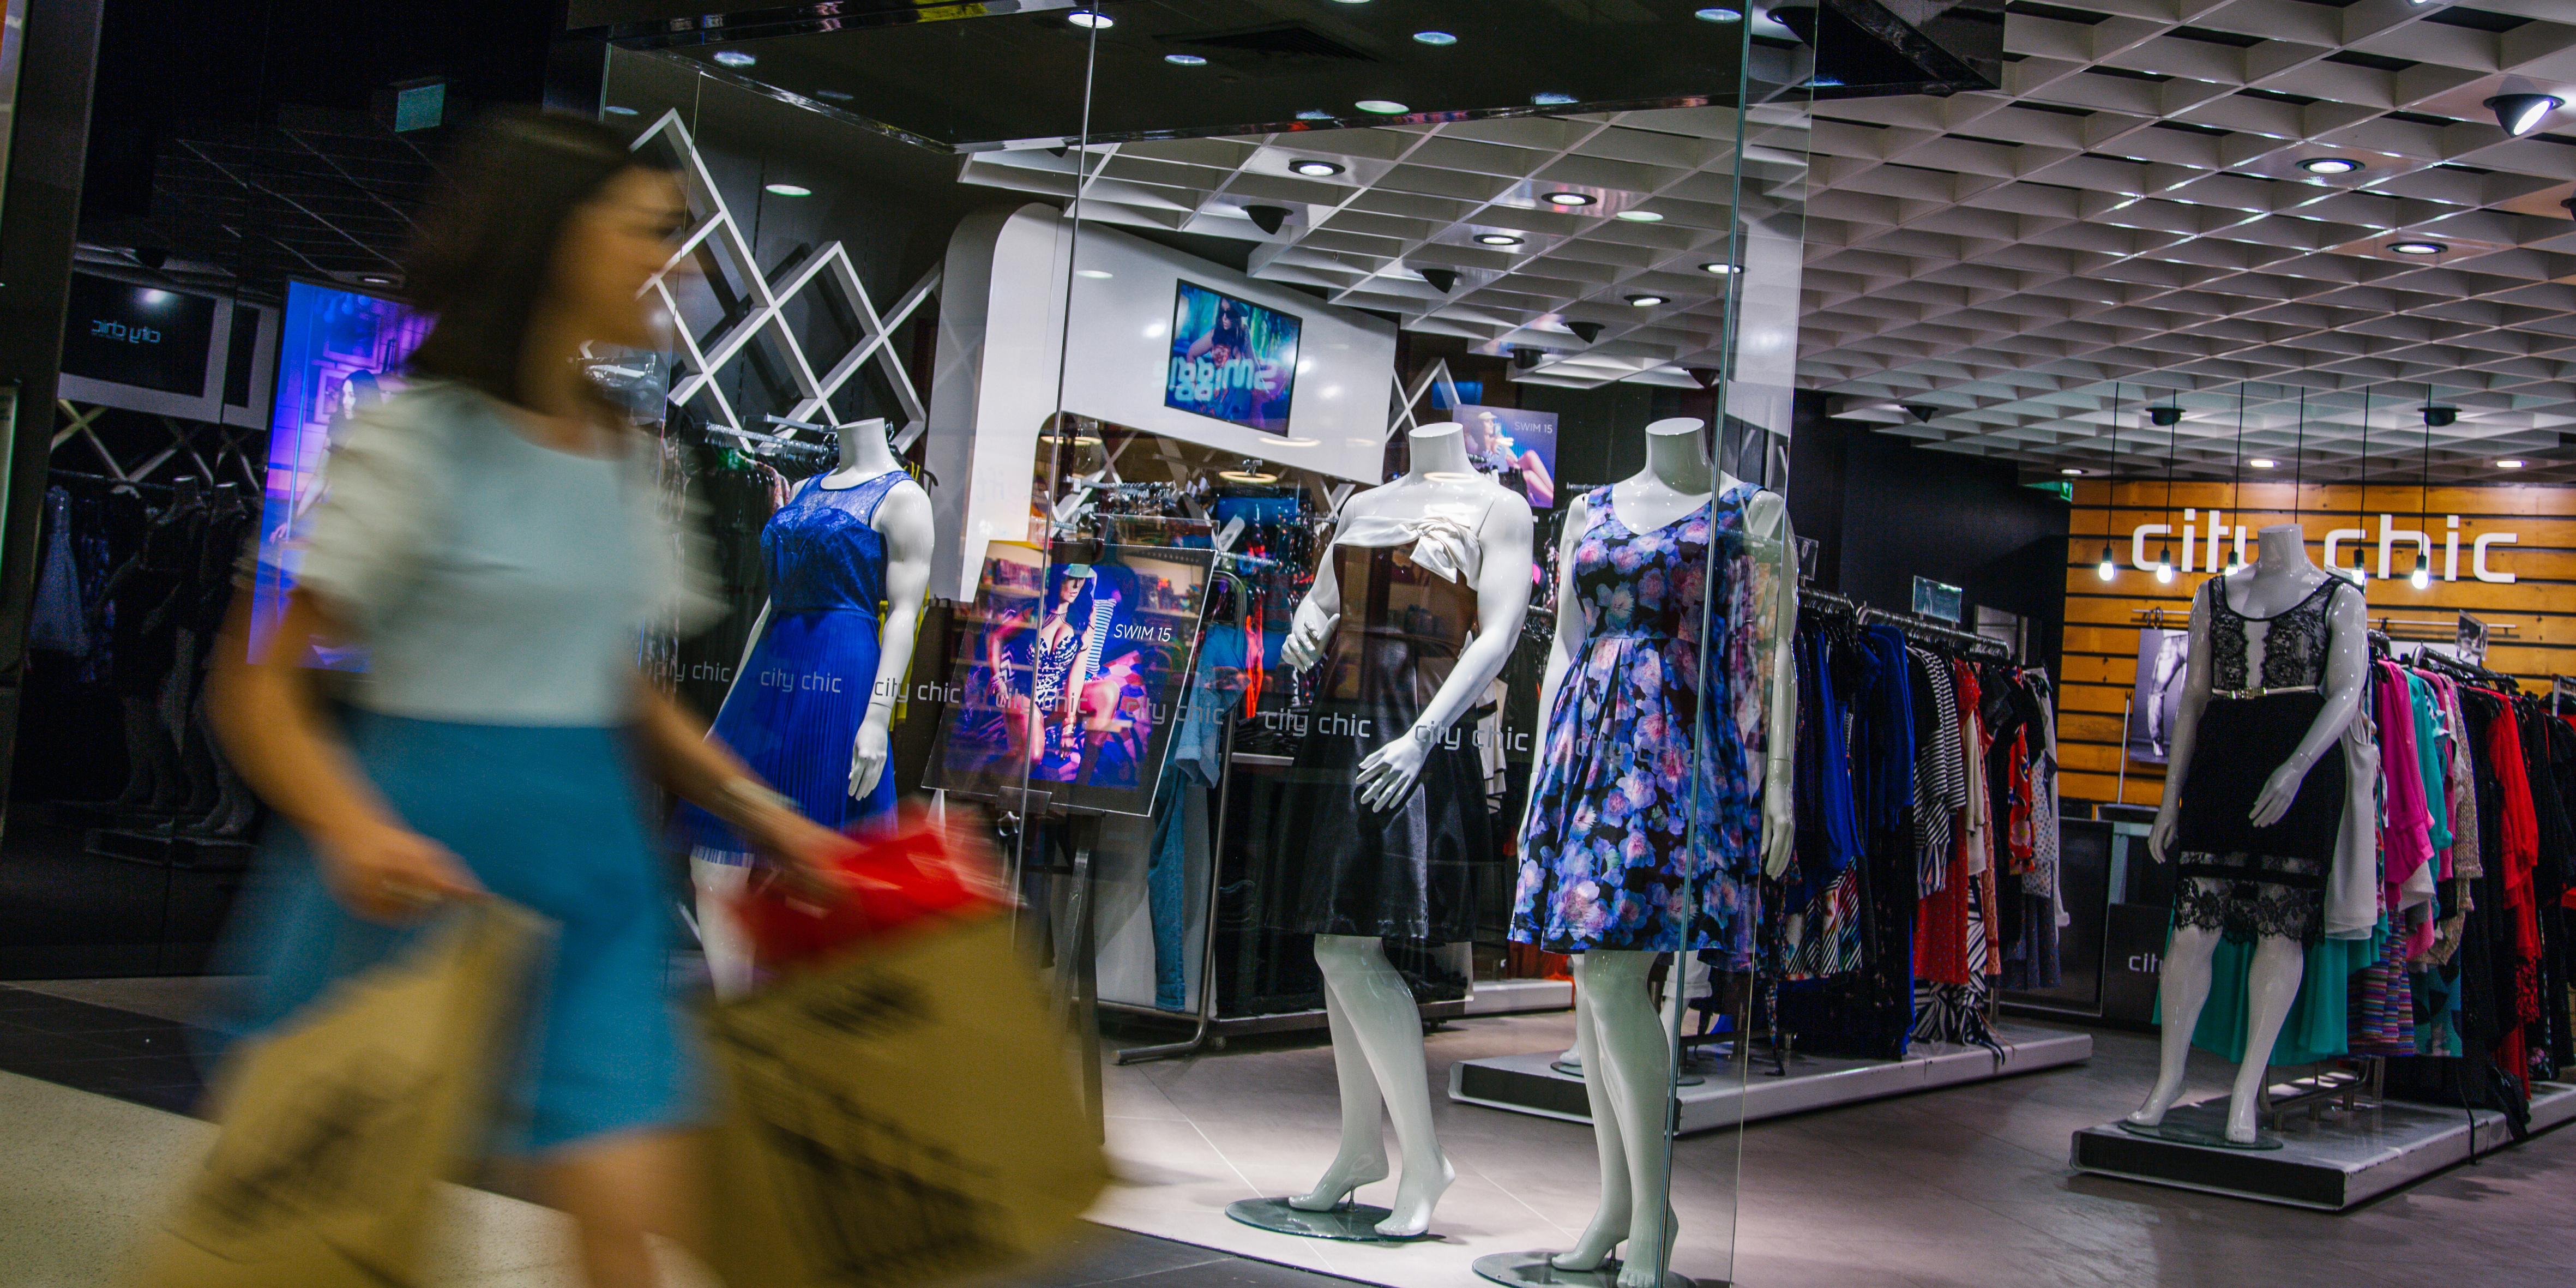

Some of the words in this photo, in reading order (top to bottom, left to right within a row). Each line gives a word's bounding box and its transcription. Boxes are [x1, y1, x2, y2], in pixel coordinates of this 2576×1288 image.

[1515, 421, 1541, 432] SWIM
[1544, 424, 1553, 434] 15
[2324, 514, 2518, 583] chic
[1114, 624, 1154, 640] SWIM
[1158, 627, 1172, 642] 15
[693, 655, 730, 682] chic
[761, 667, 794, 693] city
[802, 671, 841, 693] chic
[875, 678, 910, 703] city
[918, 681, 960, 703] chic
[1043, 690, 1088, 714] chic
[1126, 697, 1166, 725] city
[1176, 702, 1225, 725] chic
[1265, 708, 1308, 737] city
[1319, 712, 1371, 738] chic
[1415, 720, 1461, 750] city
[1472, 725, 1528, 751] chic
[1575, 733, 1624, 764] city
[1637, 740, 1694, 768] chic
[2129, 953, 2163, 979] cit
